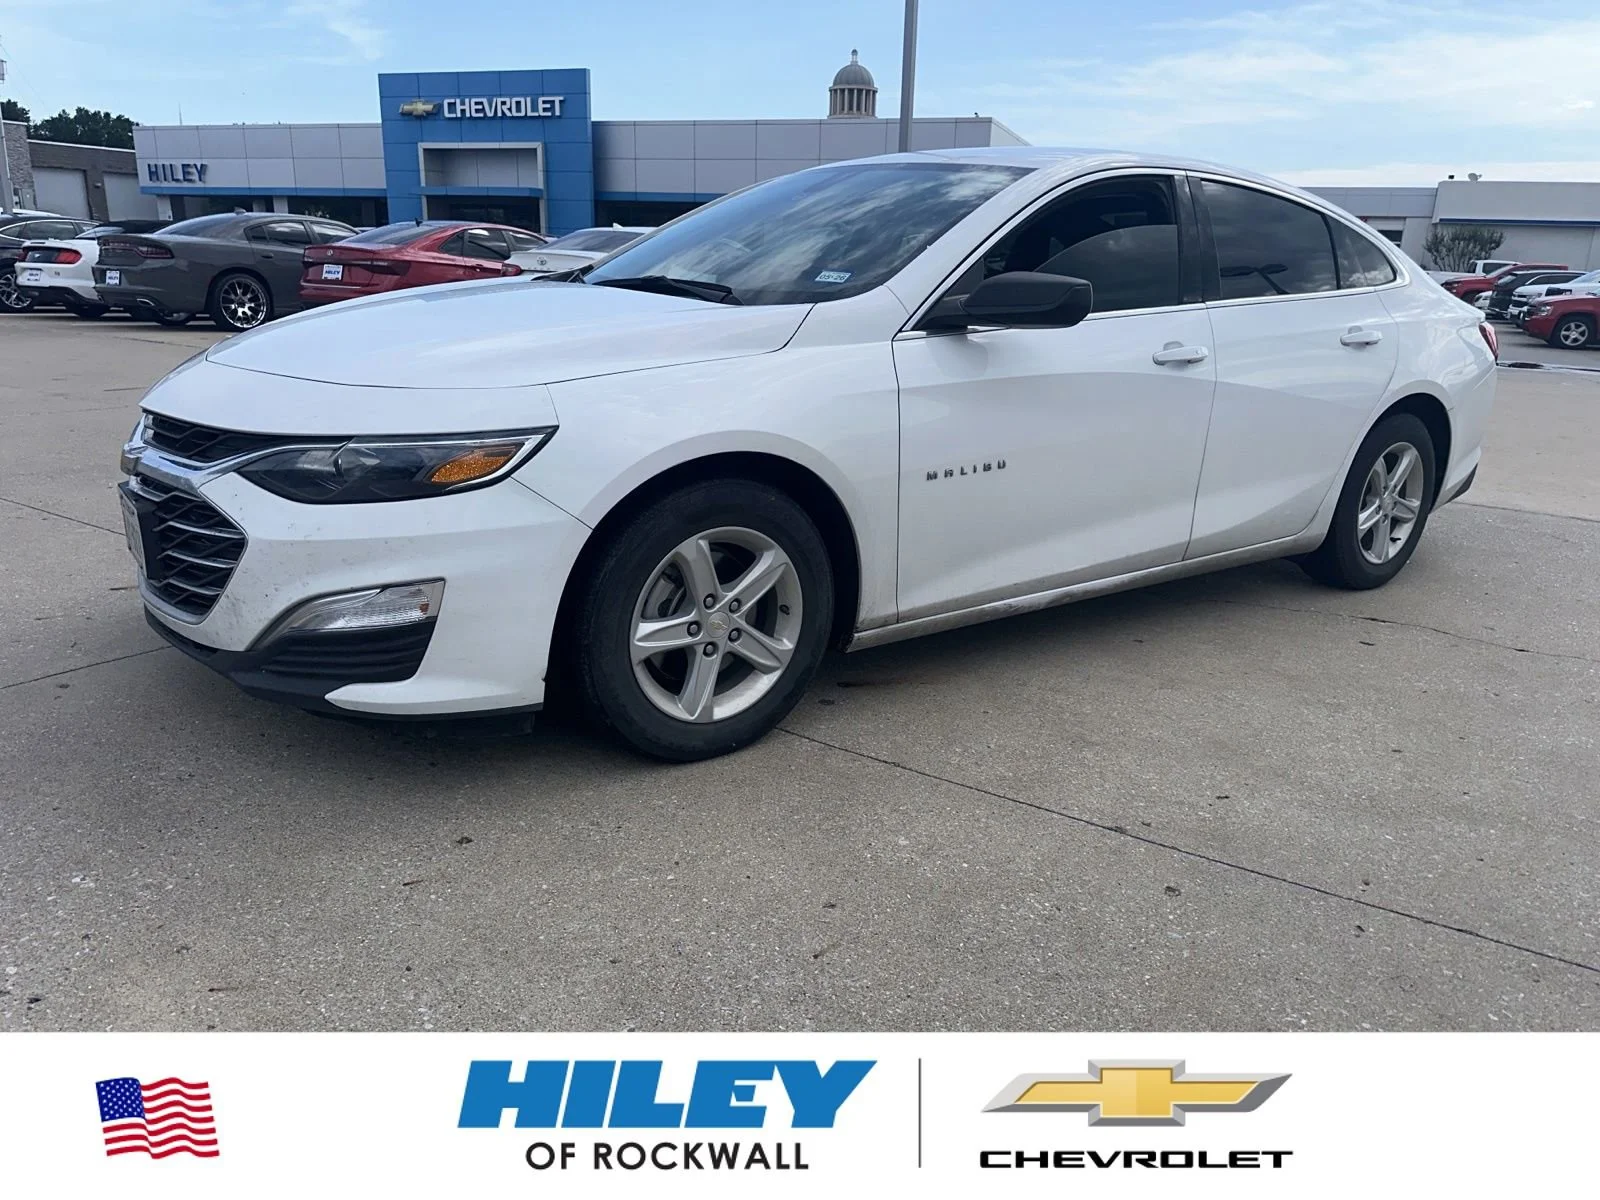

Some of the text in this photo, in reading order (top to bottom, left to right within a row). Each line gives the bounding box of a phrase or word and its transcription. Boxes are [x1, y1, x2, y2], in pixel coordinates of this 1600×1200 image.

[443, 96, 564, 118] CHEVROLET
[147, 163, 208, 183] HILEY
[926, 459, 1007, 481] MALIBU
